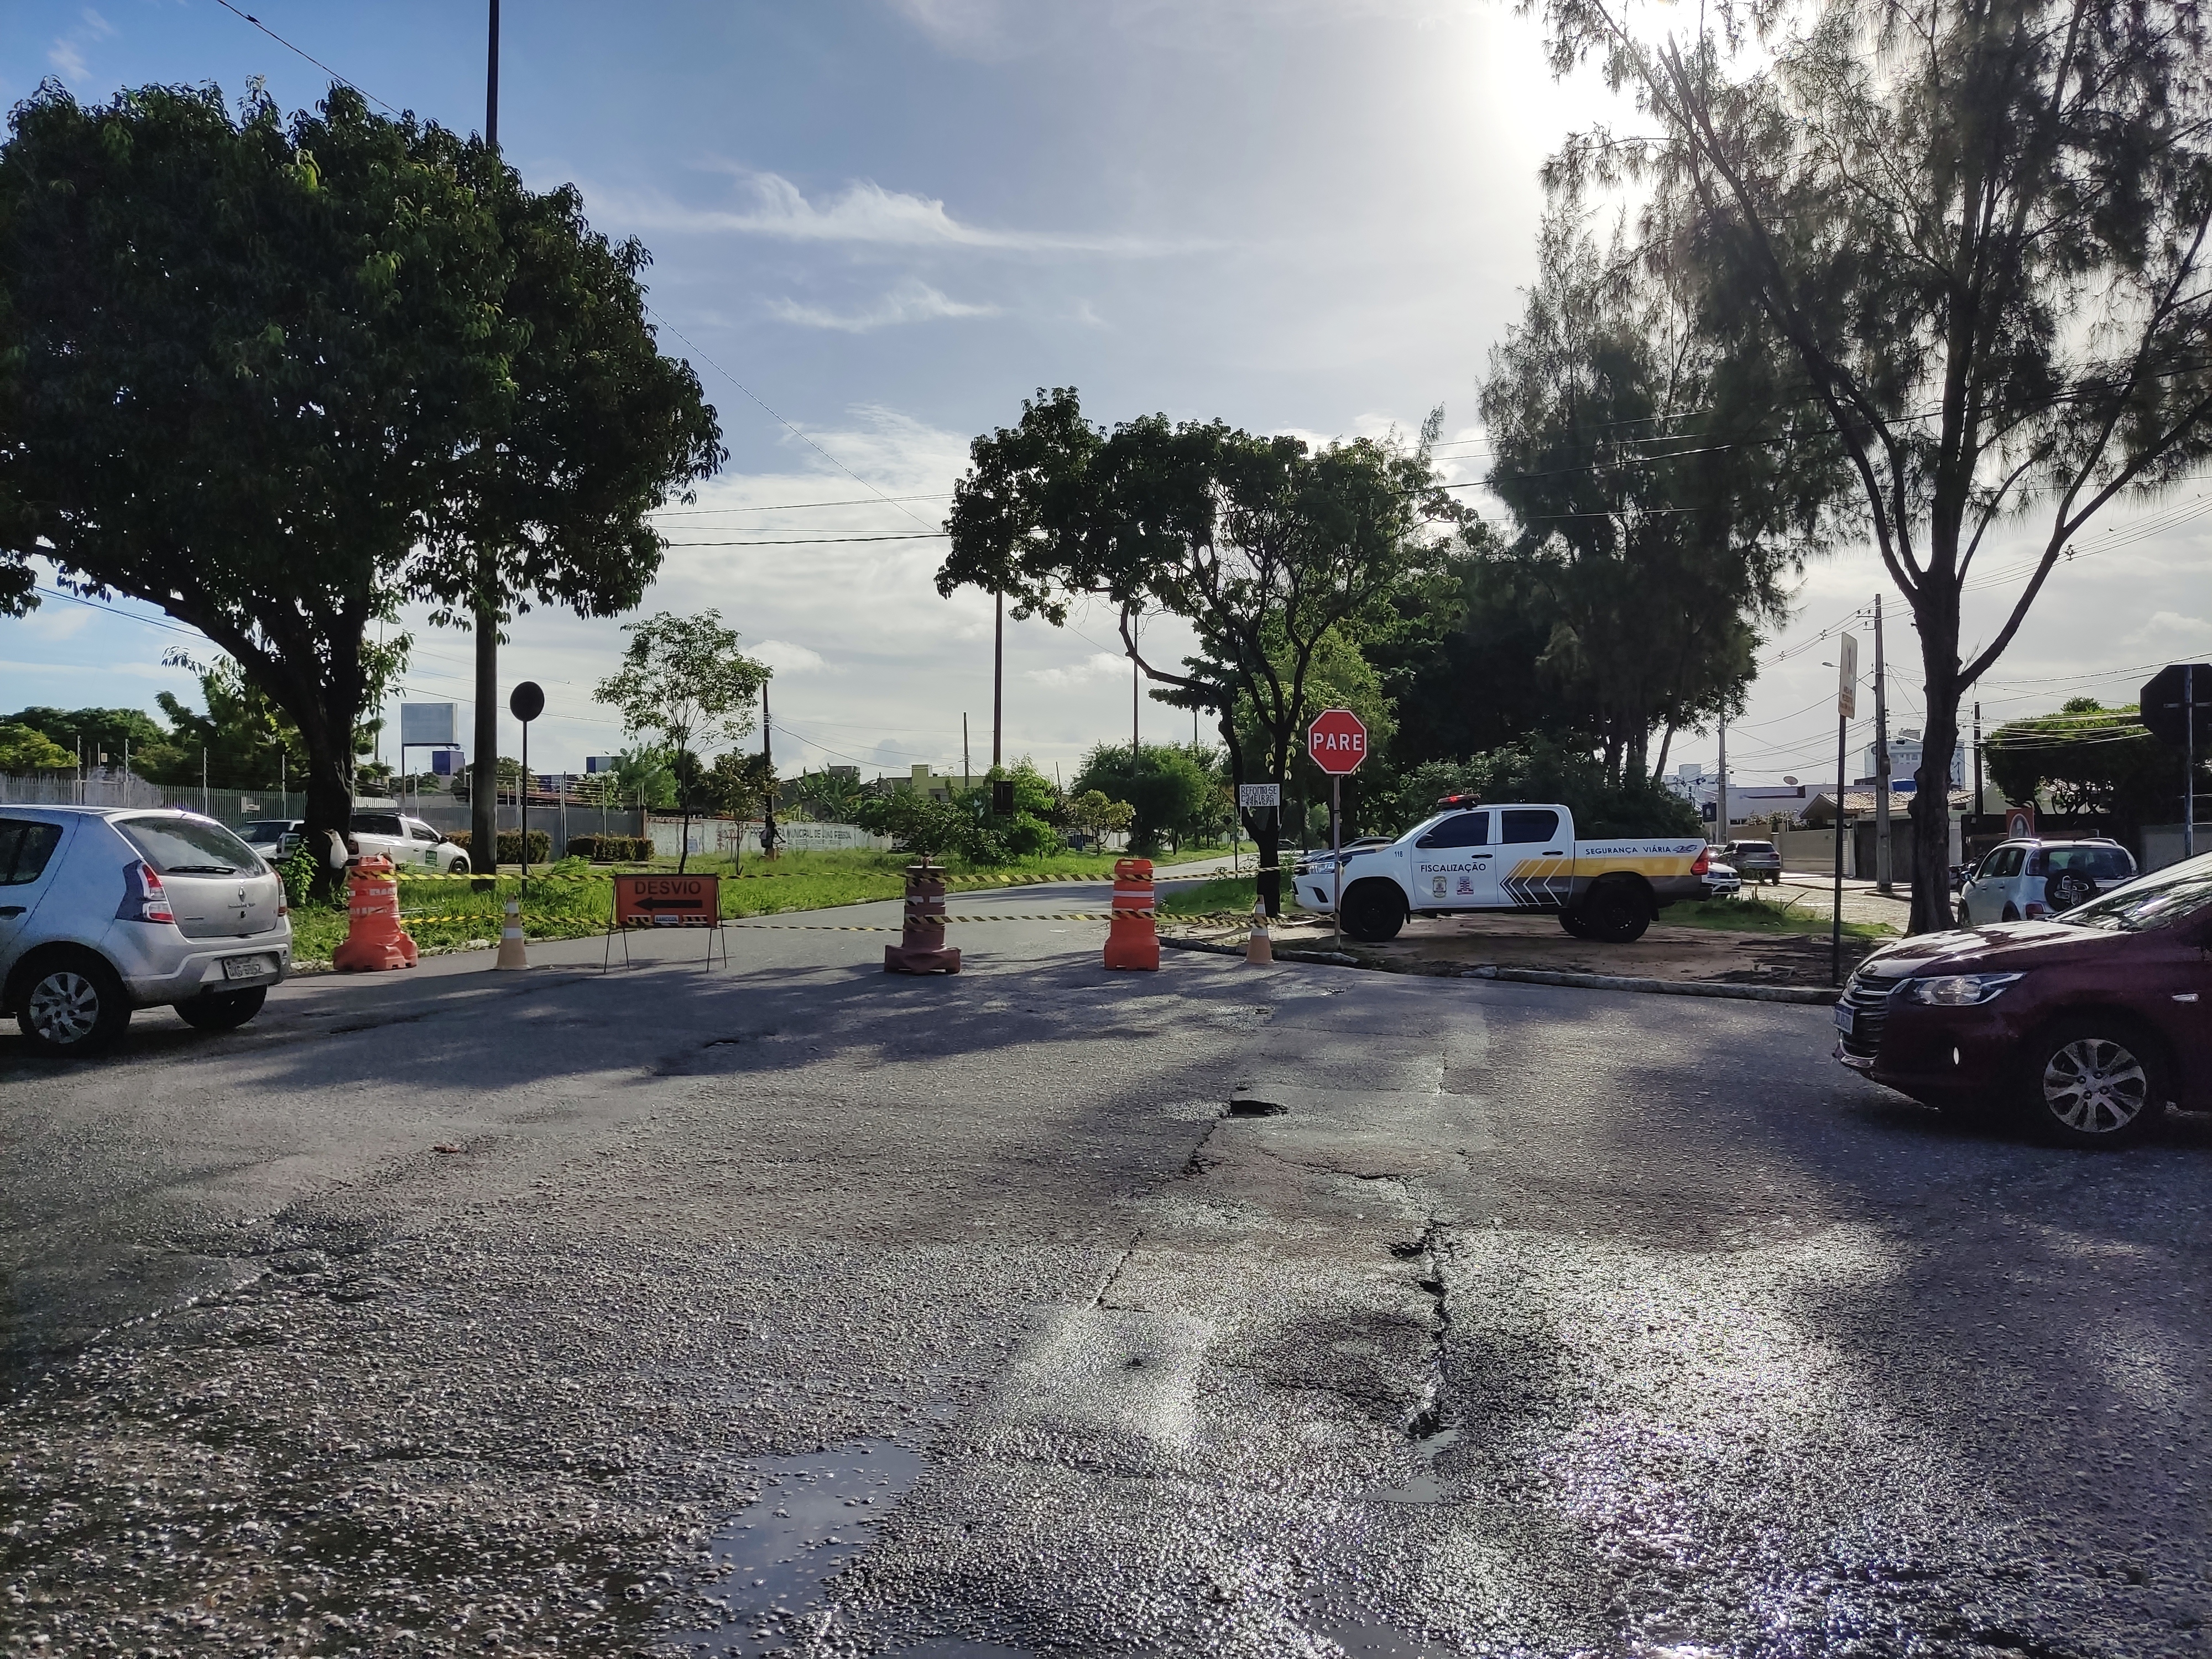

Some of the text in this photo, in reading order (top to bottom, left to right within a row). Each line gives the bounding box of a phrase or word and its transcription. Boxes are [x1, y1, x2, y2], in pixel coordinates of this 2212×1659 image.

[1313, 733, 1363, 751] PARE
[1421, 862, 1486, 873] FISCALIZAÇÃO
[634, 881, 701, 894] DESVIO
